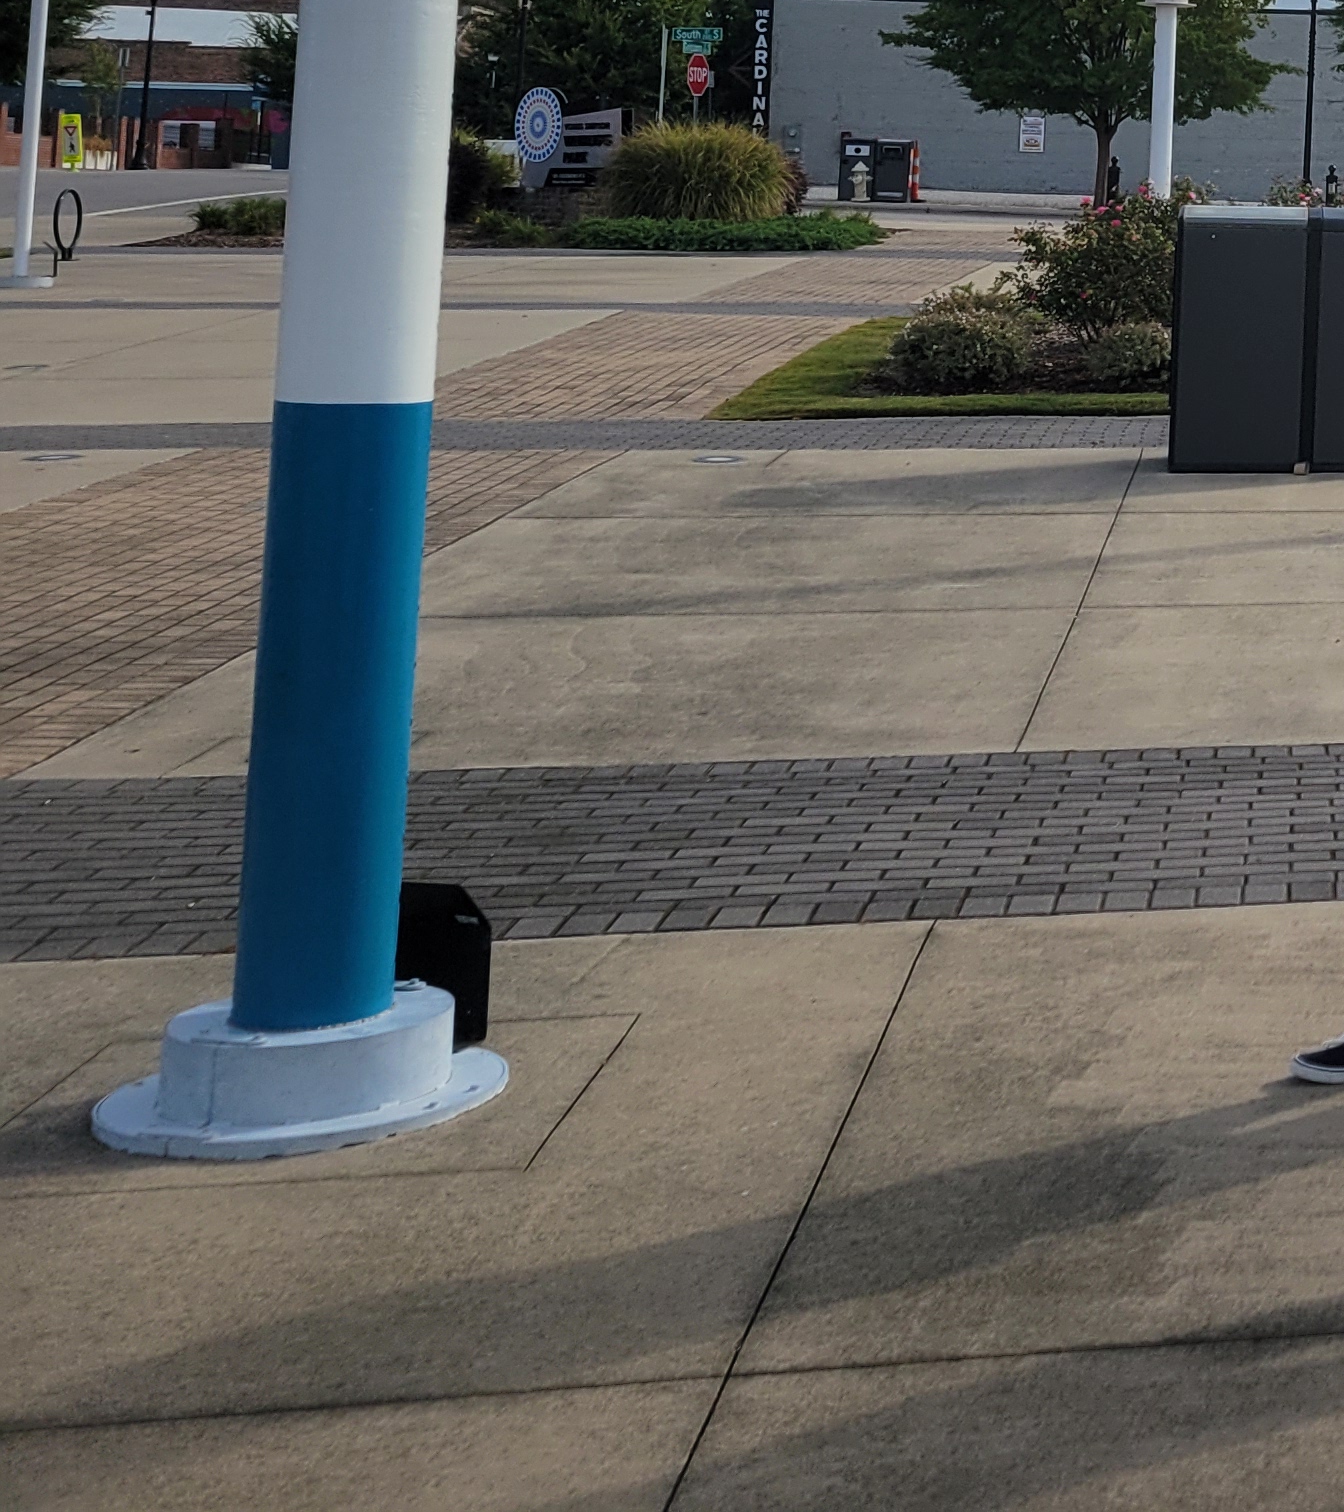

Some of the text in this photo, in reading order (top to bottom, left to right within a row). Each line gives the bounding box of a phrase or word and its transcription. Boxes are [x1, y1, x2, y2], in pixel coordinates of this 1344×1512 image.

[755, 9, 770, 18] THE
[675, 29, 701, 40] South
[712, 29, 719, 40] S
[689, 67, 708, 83] STOP
